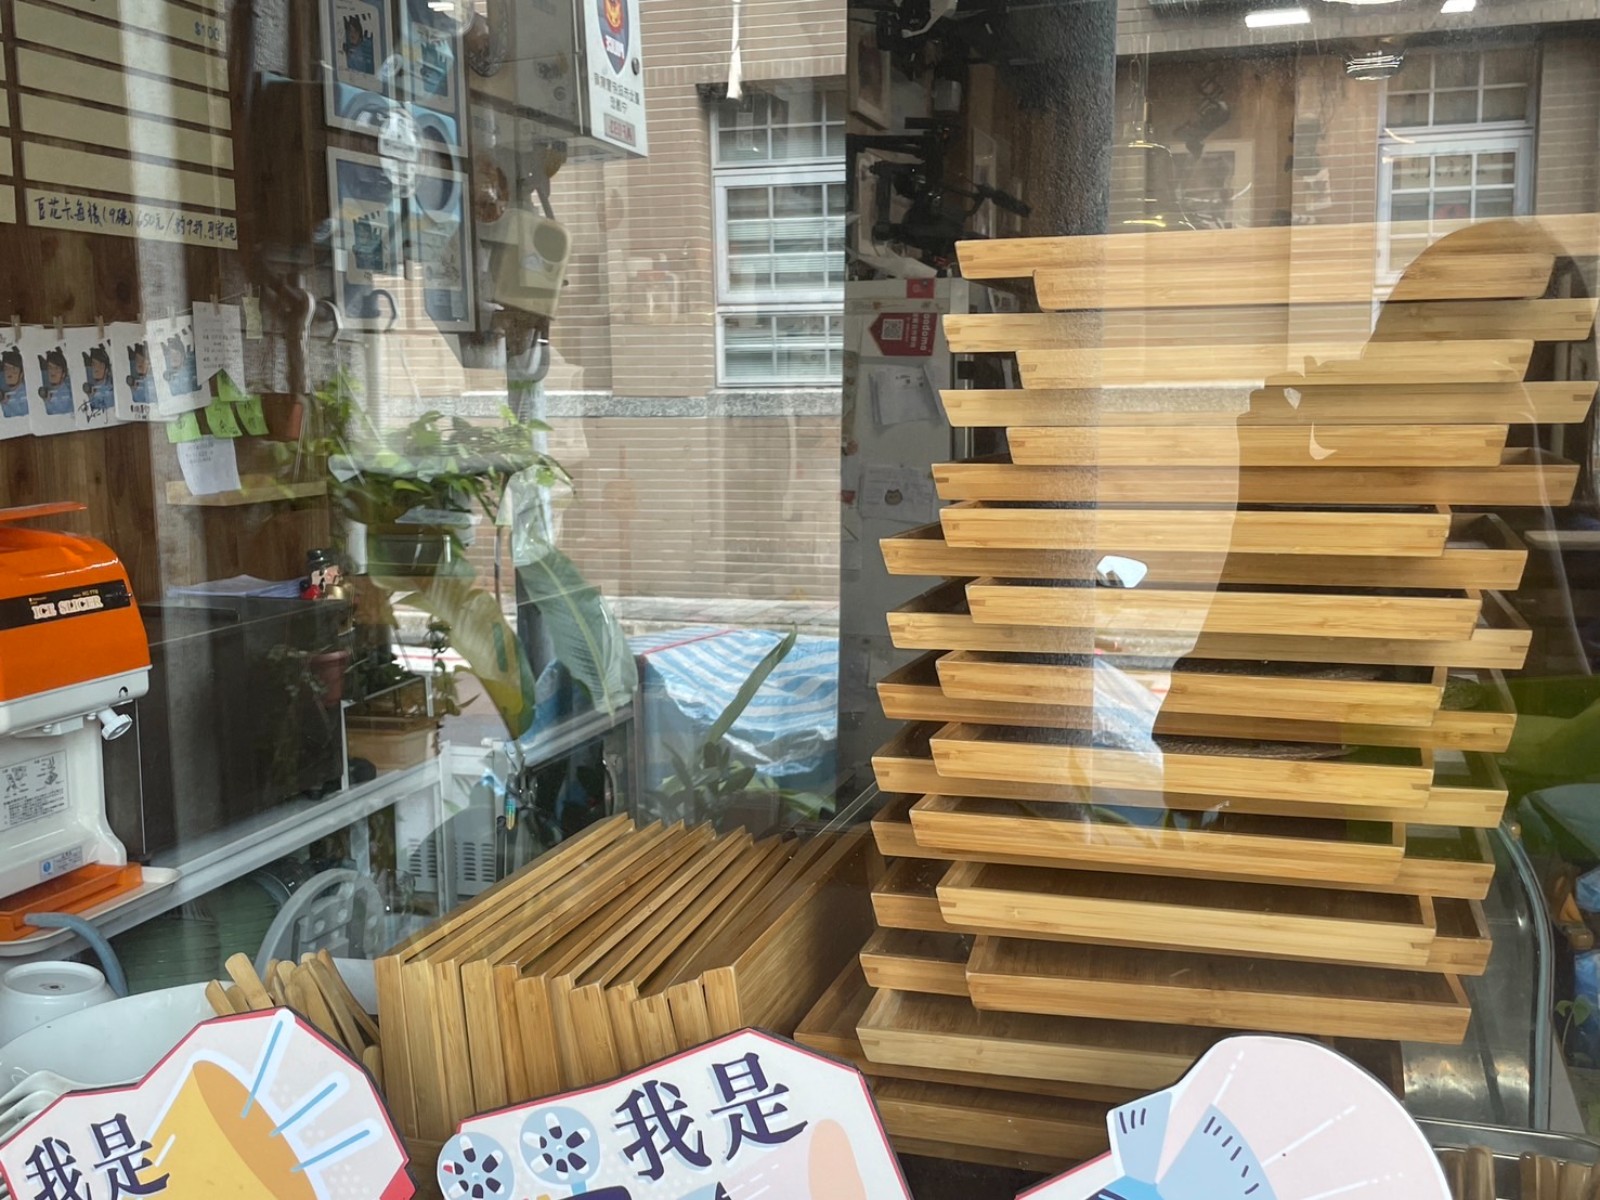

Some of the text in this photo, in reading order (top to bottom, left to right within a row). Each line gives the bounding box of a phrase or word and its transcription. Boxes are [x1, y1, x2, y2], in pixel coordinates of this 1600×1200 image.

[32, 596, 103, 620] ICE SLICER
[25, 1112, 170, 1199] 我是
[614, 1052, 808, 1181] 我是
